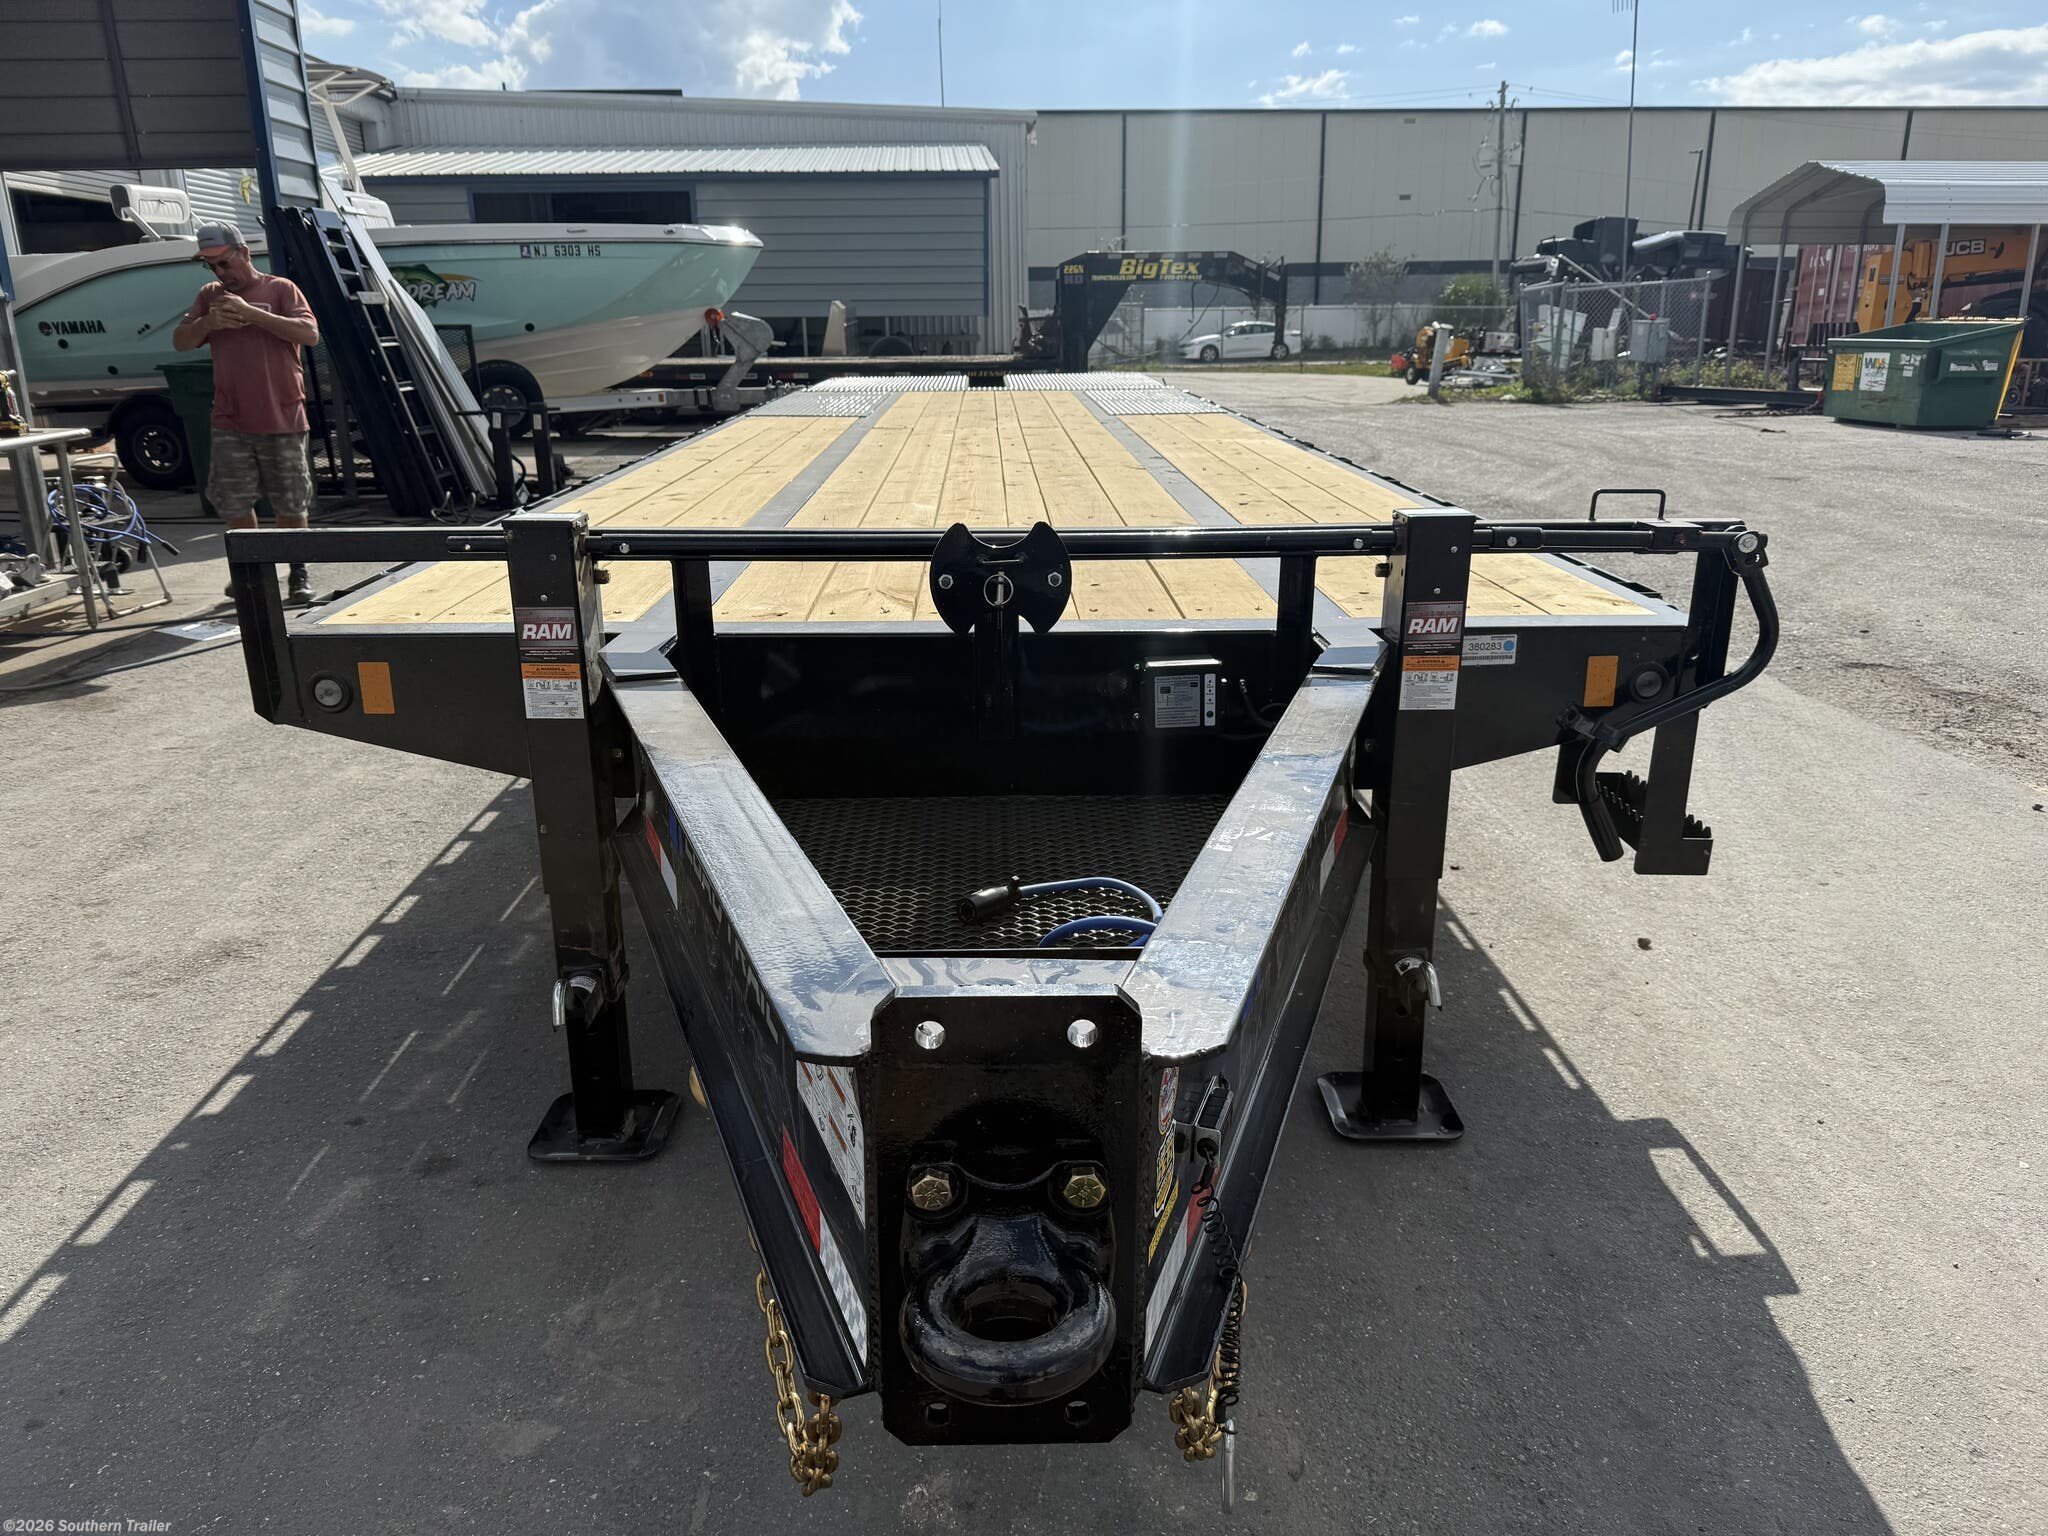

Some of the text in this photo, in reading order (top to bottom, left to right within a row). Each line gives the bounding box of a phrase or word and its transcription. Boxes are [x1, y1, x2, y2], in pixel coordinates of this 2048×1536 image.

[534, 245, 601, 257] NJ 6303 HS
[1945, 240, 1985, 256] JCB
[51, 320, 106, 335] YAMAHA
[522, 623, 572, 640] RAM
[1407, 617, 1459, 635] RAM
[1468, 641, 1503, 652] 380283
